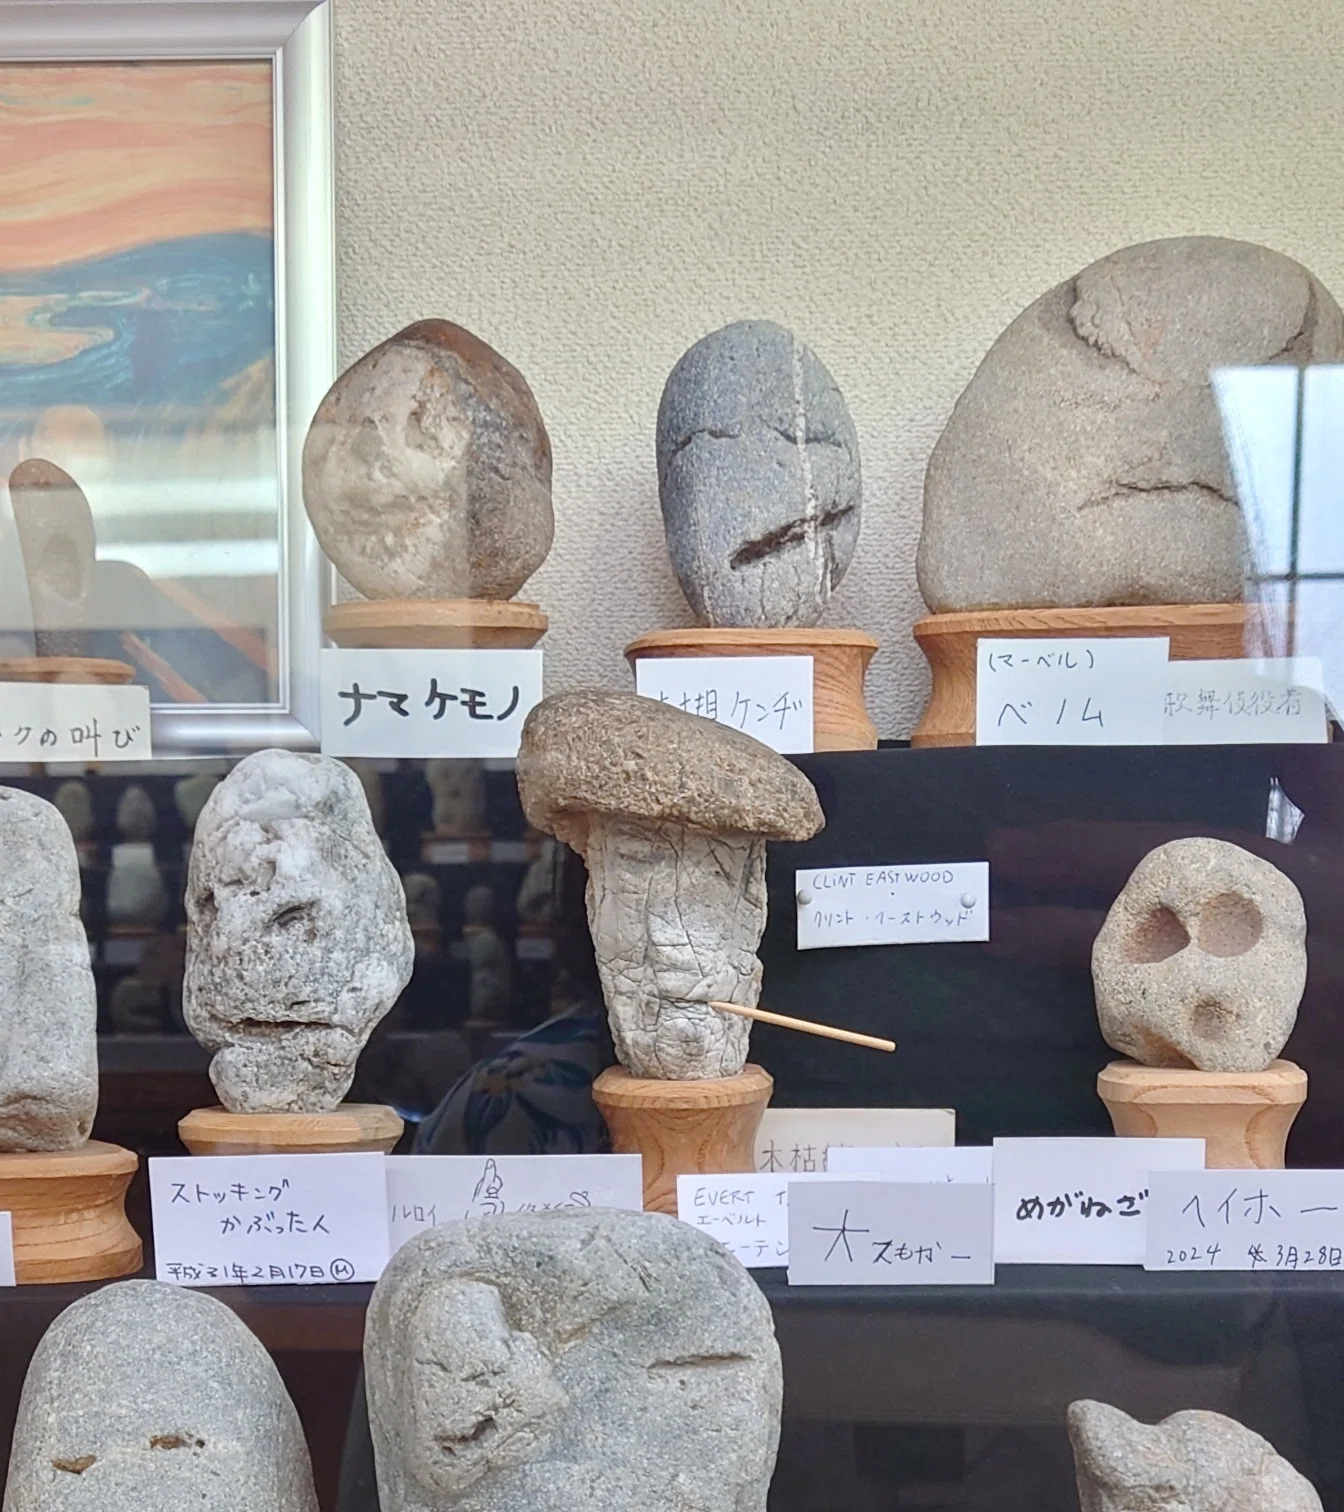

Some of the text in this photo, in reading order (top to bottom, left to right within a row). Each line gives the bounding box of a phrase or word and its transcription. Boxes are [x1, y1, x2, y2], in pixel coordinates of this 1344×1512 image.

[338, 678, 519, 726] ナマケモノ
[998, 698, 1104, 728] ベノム
[171, 1178, 290, 1203] ストッキング
[1182, 1188, 1339, 1228] ヘイホー
[220, 1210, 330, 1234] かぶった人
[1166, 1243, 1222, 1265] 2024
